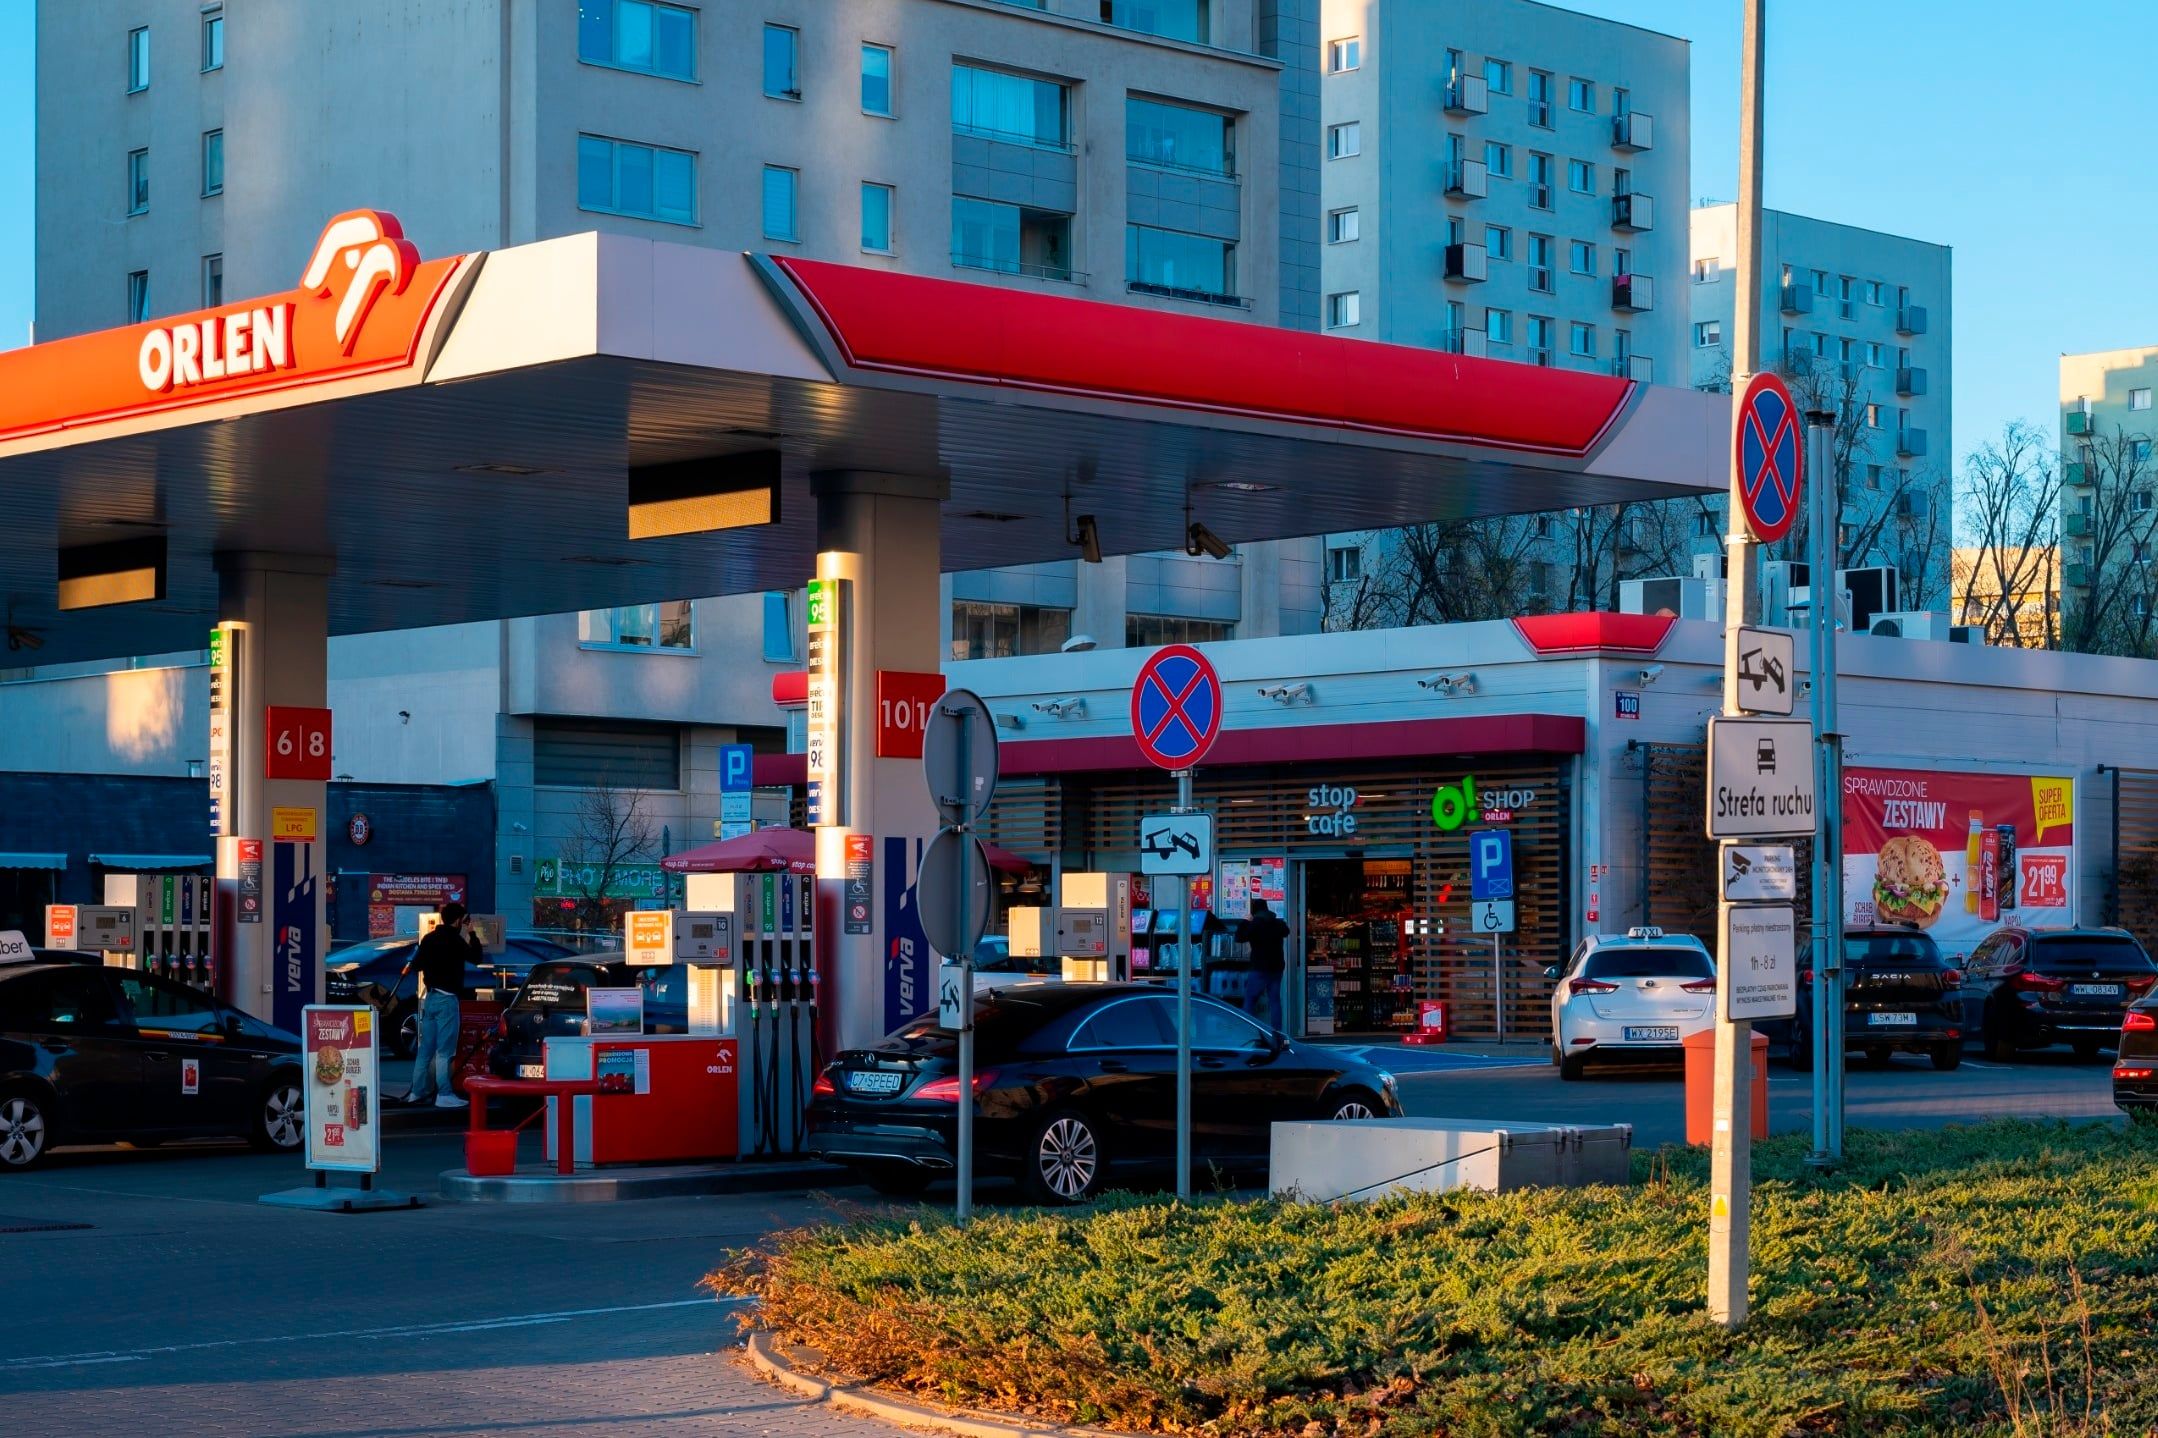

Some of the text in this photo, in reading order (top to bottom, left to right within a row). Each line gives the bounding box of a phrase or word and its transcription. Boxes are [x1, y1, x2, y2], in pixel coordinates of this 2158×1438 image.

[139, 304, 290, 392] ORLEN
[1620, 698, 1637, 712] 100
[882, 699, 937, 730] 10 1
[728, 750, 745, 785] P
[1844, 776, 1929, 799] SPRAWDZONE
[2038, 787, 2062, 804] SUPER
[1308, 784, 1357, 812] stop
[1483, 789, 1536, 810] SHOP
[1717, 784, 1813, 817] Strefa ruchu
[1484, 811, 1511, 822] ORLEN
[1882, 799, 1947, 830] ZESTAWY
[2038, 804, 2067, 821] OFERTA
[285, 823, 304, 833] LPG
[1308, 810, 1357, 838] cafe
[1480, 838, 1503, 878] P
[717, 921, 726, 930] 10
[1633, 928, 1660, 937] TAXI
[0, 939, 24, 955] ber
[288, 926, 302, 993] verva
[1750, 955, 1759, 971] 1h
[900, 936, 914, 1017] verva
[318, 1028, 345, 1041] ZESTAWY
[1630, 1028, 1676, 1038] WX 2195E
[706, 1065, 733, 1074] ORLEN
[852, 1073, 900, 1089] C7 SPEED
